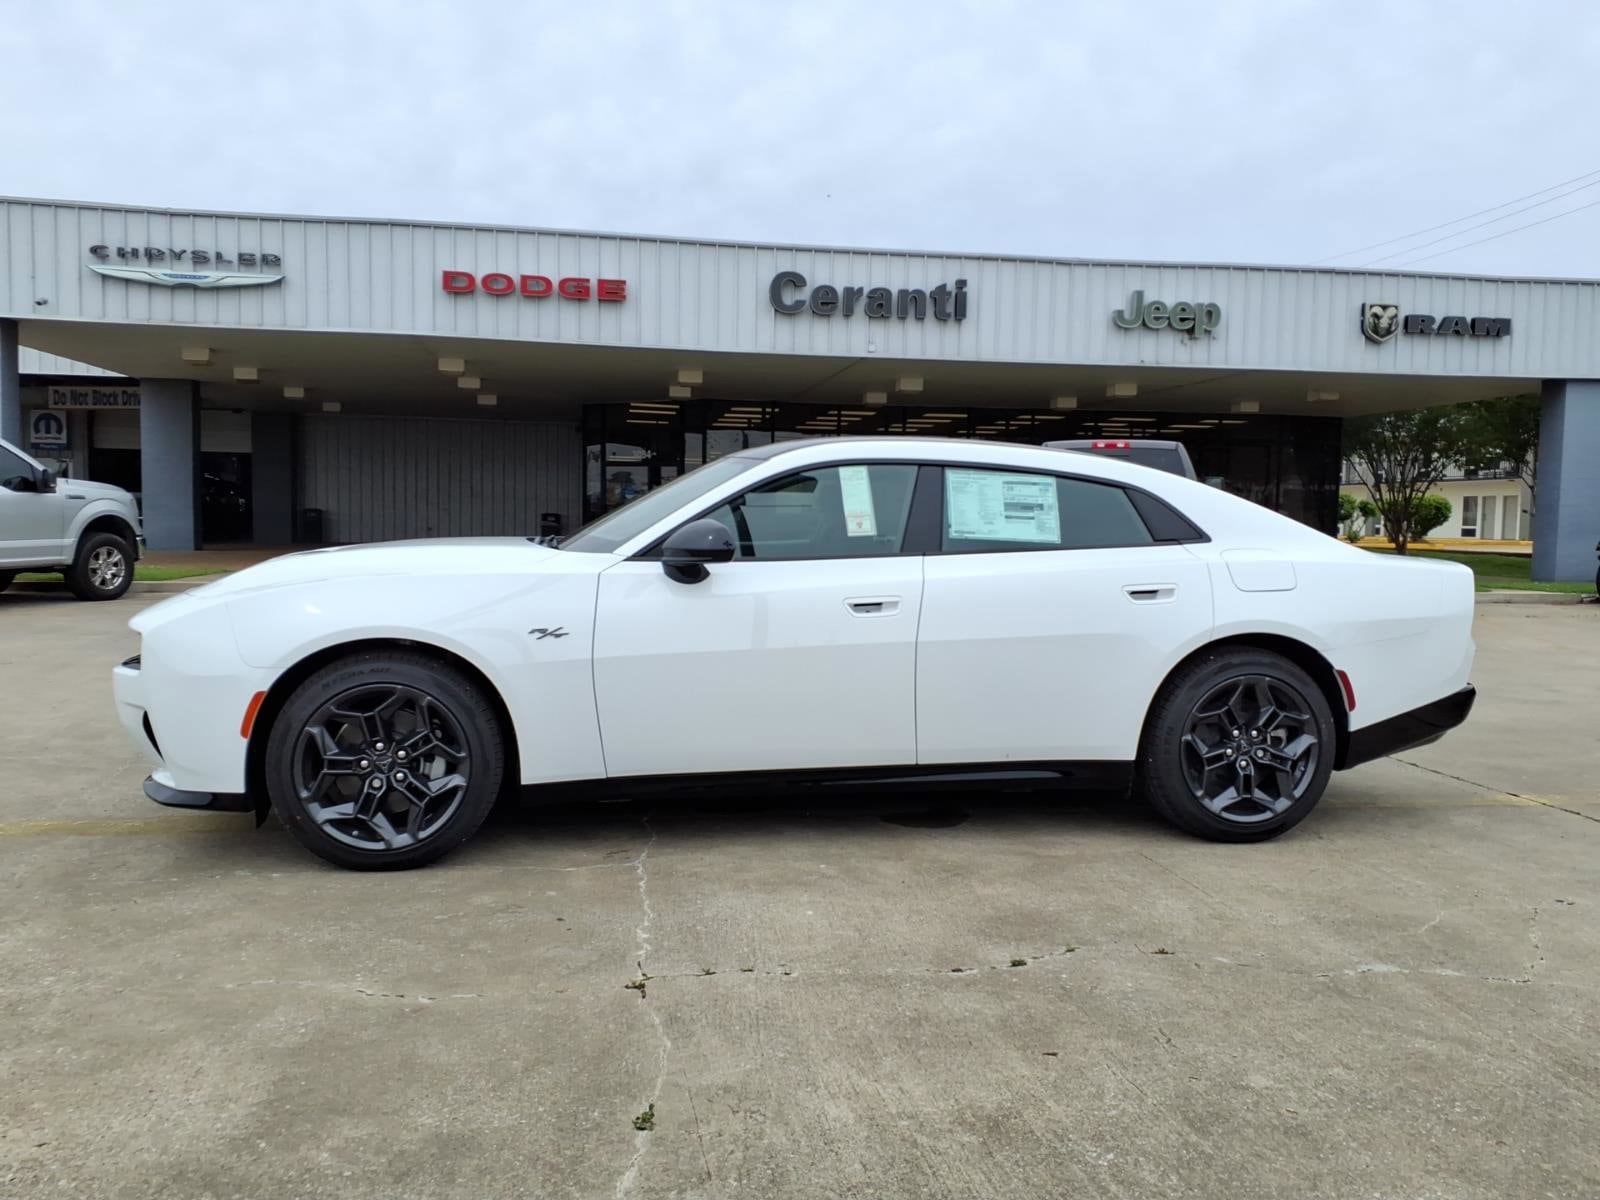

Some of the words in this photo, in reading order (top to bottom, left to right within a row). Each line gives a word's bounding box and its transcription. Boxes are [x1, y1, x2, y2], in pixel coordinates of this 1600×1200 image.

[90, 245, 281, 266] CHRYSLER
[442, 270, 627, 302] DODGE
[769, 270, 968, 322] Ceranti
[1112, 290, 1222, 338] Jeep
[1403, 314, 1512, 338] RAM
[53, 390, 66, 406] Do
[70, 390, 89, 406] Not
[91, 390, 119, 406] Block
